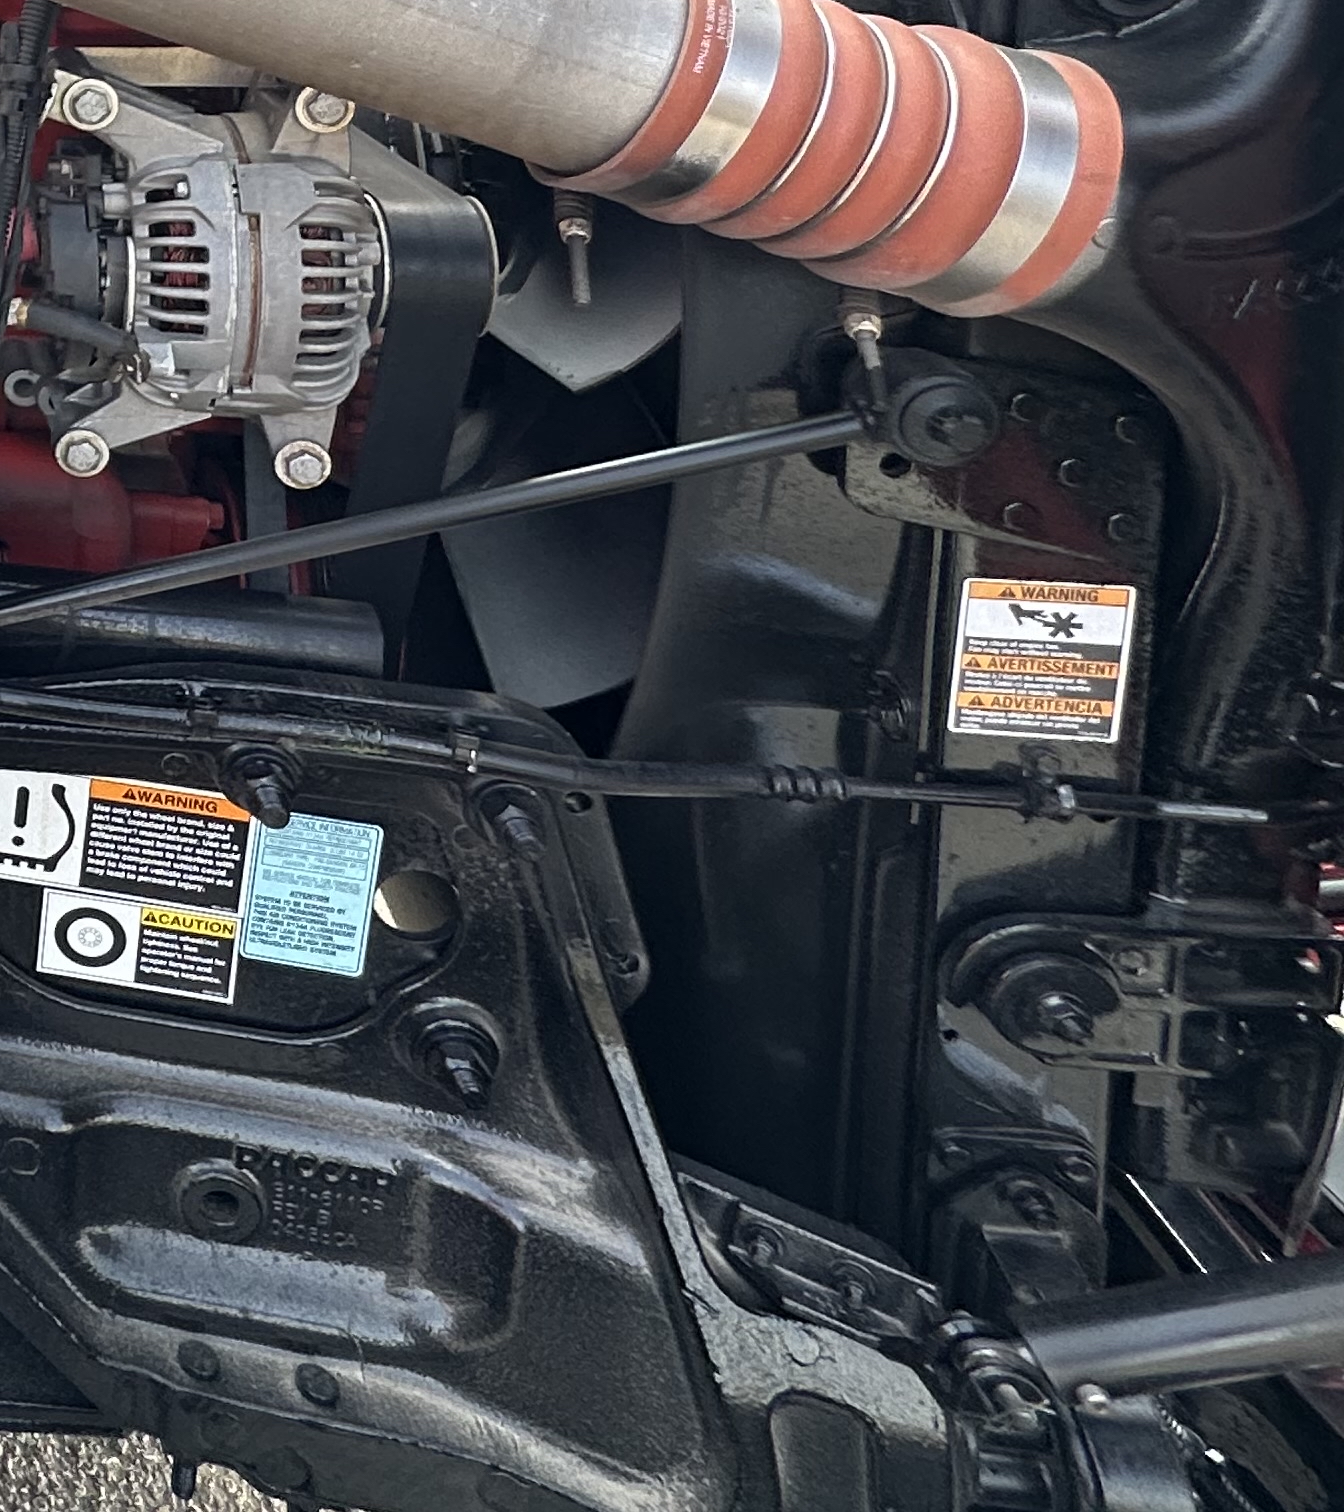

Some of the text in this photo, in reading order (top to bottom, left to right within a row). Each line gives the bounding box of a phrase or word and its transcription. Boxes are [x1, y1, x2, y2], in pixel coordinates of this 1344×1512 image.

[1020, 586, 1099, 602] WARNING
[987, 656, 1116, 676] AVERTISSEMENT
[990, 695, 1103, 715] ADVERTENCIA
[137, 790, 218, 814] WARNING
[158, 913, 234, 935] CAUTION
[233, 1141, 392, 1186] PACCAR
